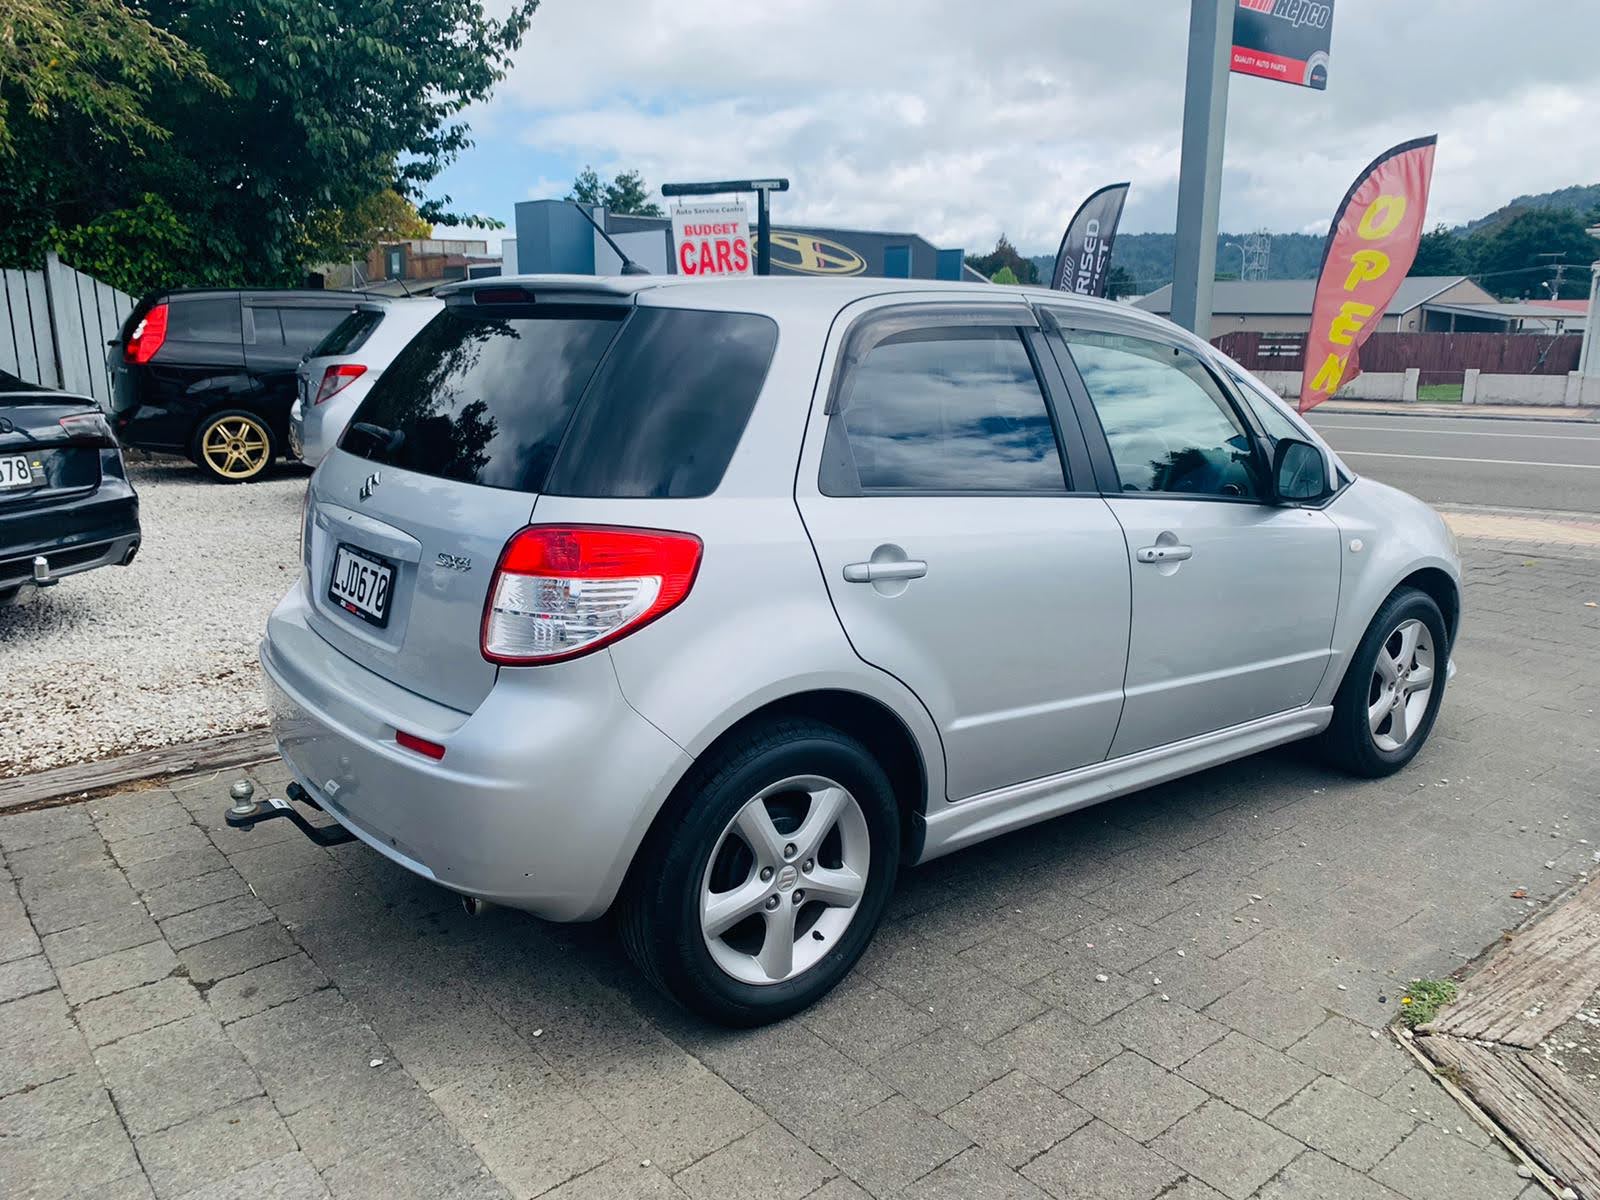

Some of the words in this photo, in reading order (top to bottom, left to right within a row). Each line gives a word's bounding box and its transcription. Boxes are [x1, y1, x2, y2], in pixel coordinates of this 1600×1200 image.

[1233, 54, 1256, 66] QUALITY
[1256, 59, 1270, 69] AUTO
[1270, 62, 1287, 73] PARTS
[676, 208, 693, 216] Auto
[694, 207, 720, 215] Service
[721, 205, 744, 213] Centre
[684, 222, 738, 237] BUDGET
[680, 238, 749, 275] CARS
[1309, 194, 1407, 396] OPEN
[435, 552, 472, 573] SX4
[333, 553, 389, 612] LJD670
